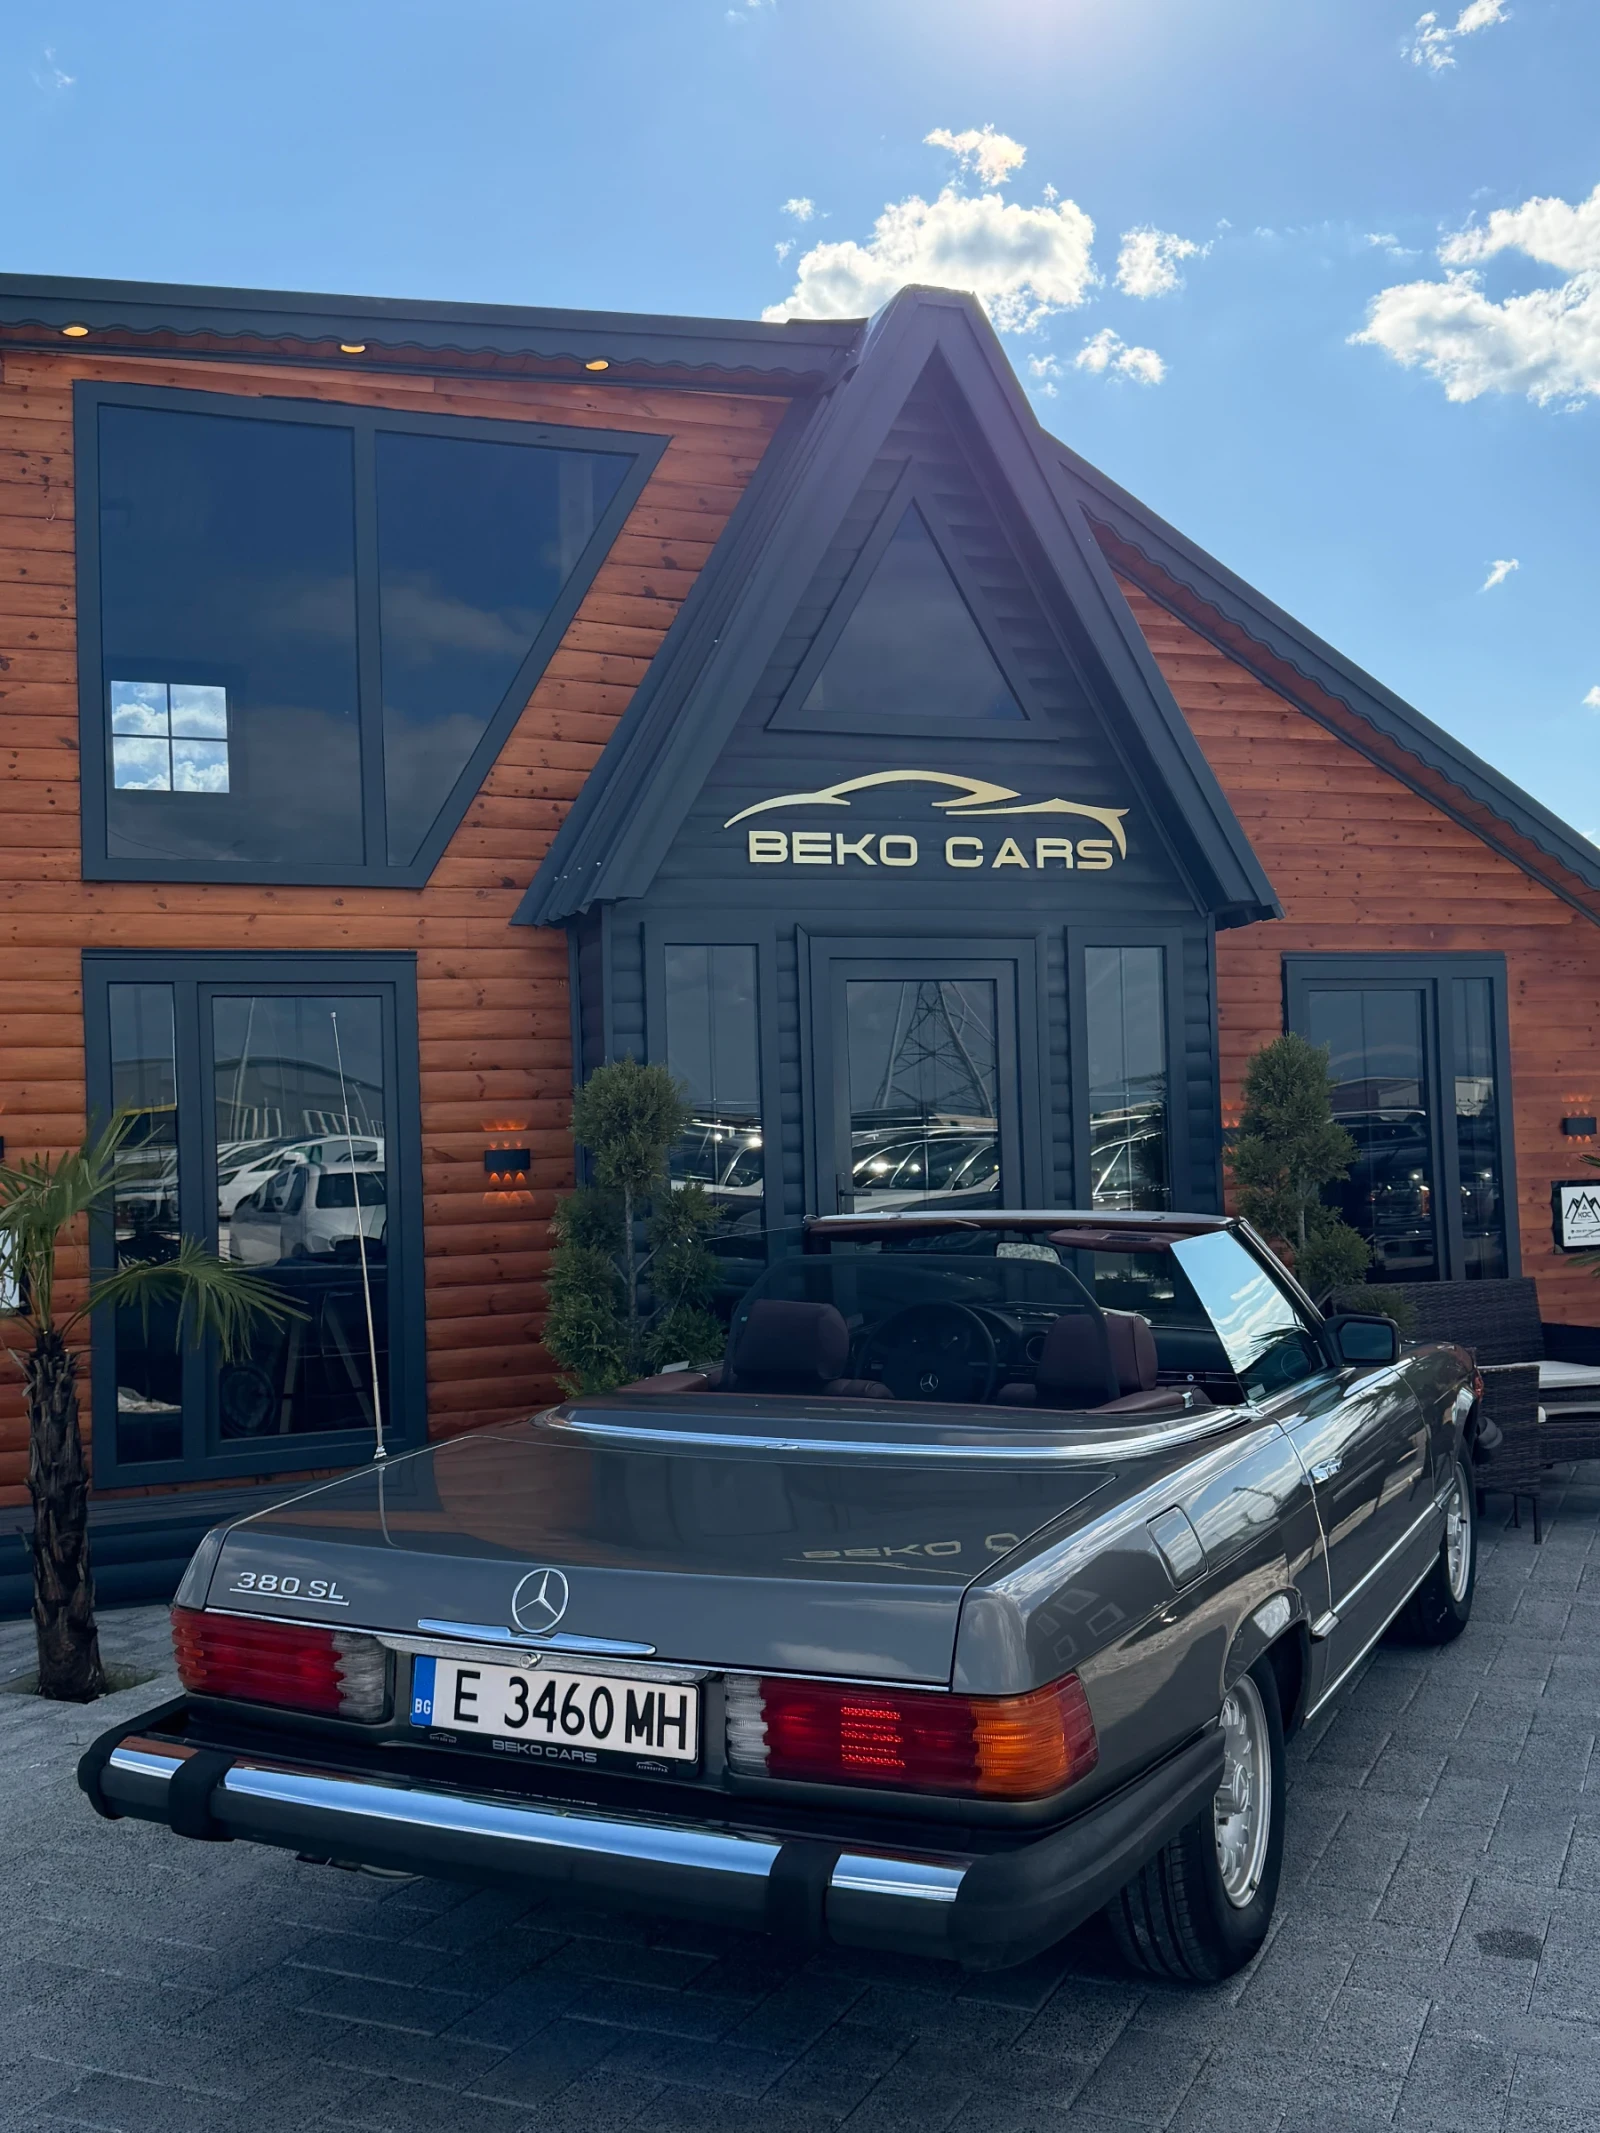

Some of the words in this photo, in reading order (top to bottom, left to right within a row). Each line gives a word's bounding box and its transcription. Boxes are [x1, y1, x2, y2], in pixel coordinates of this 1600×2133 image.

[748, 830, 918, 866] BEKO
[945, 836, 1114, 870] CARS
[237, 1572, 300, 1594] 380
[308, 1580, 344, 1600] SL
[414, 1698, 432, 1715] BG
[453, 1669, 481, 1724] E
[504, 1676, 614, 1740] 3460
[624, 1689, 688, 1750] MH
[492, 1739, 543, 1756] BEKO
[545, 1747, 598, 1763] CARS
